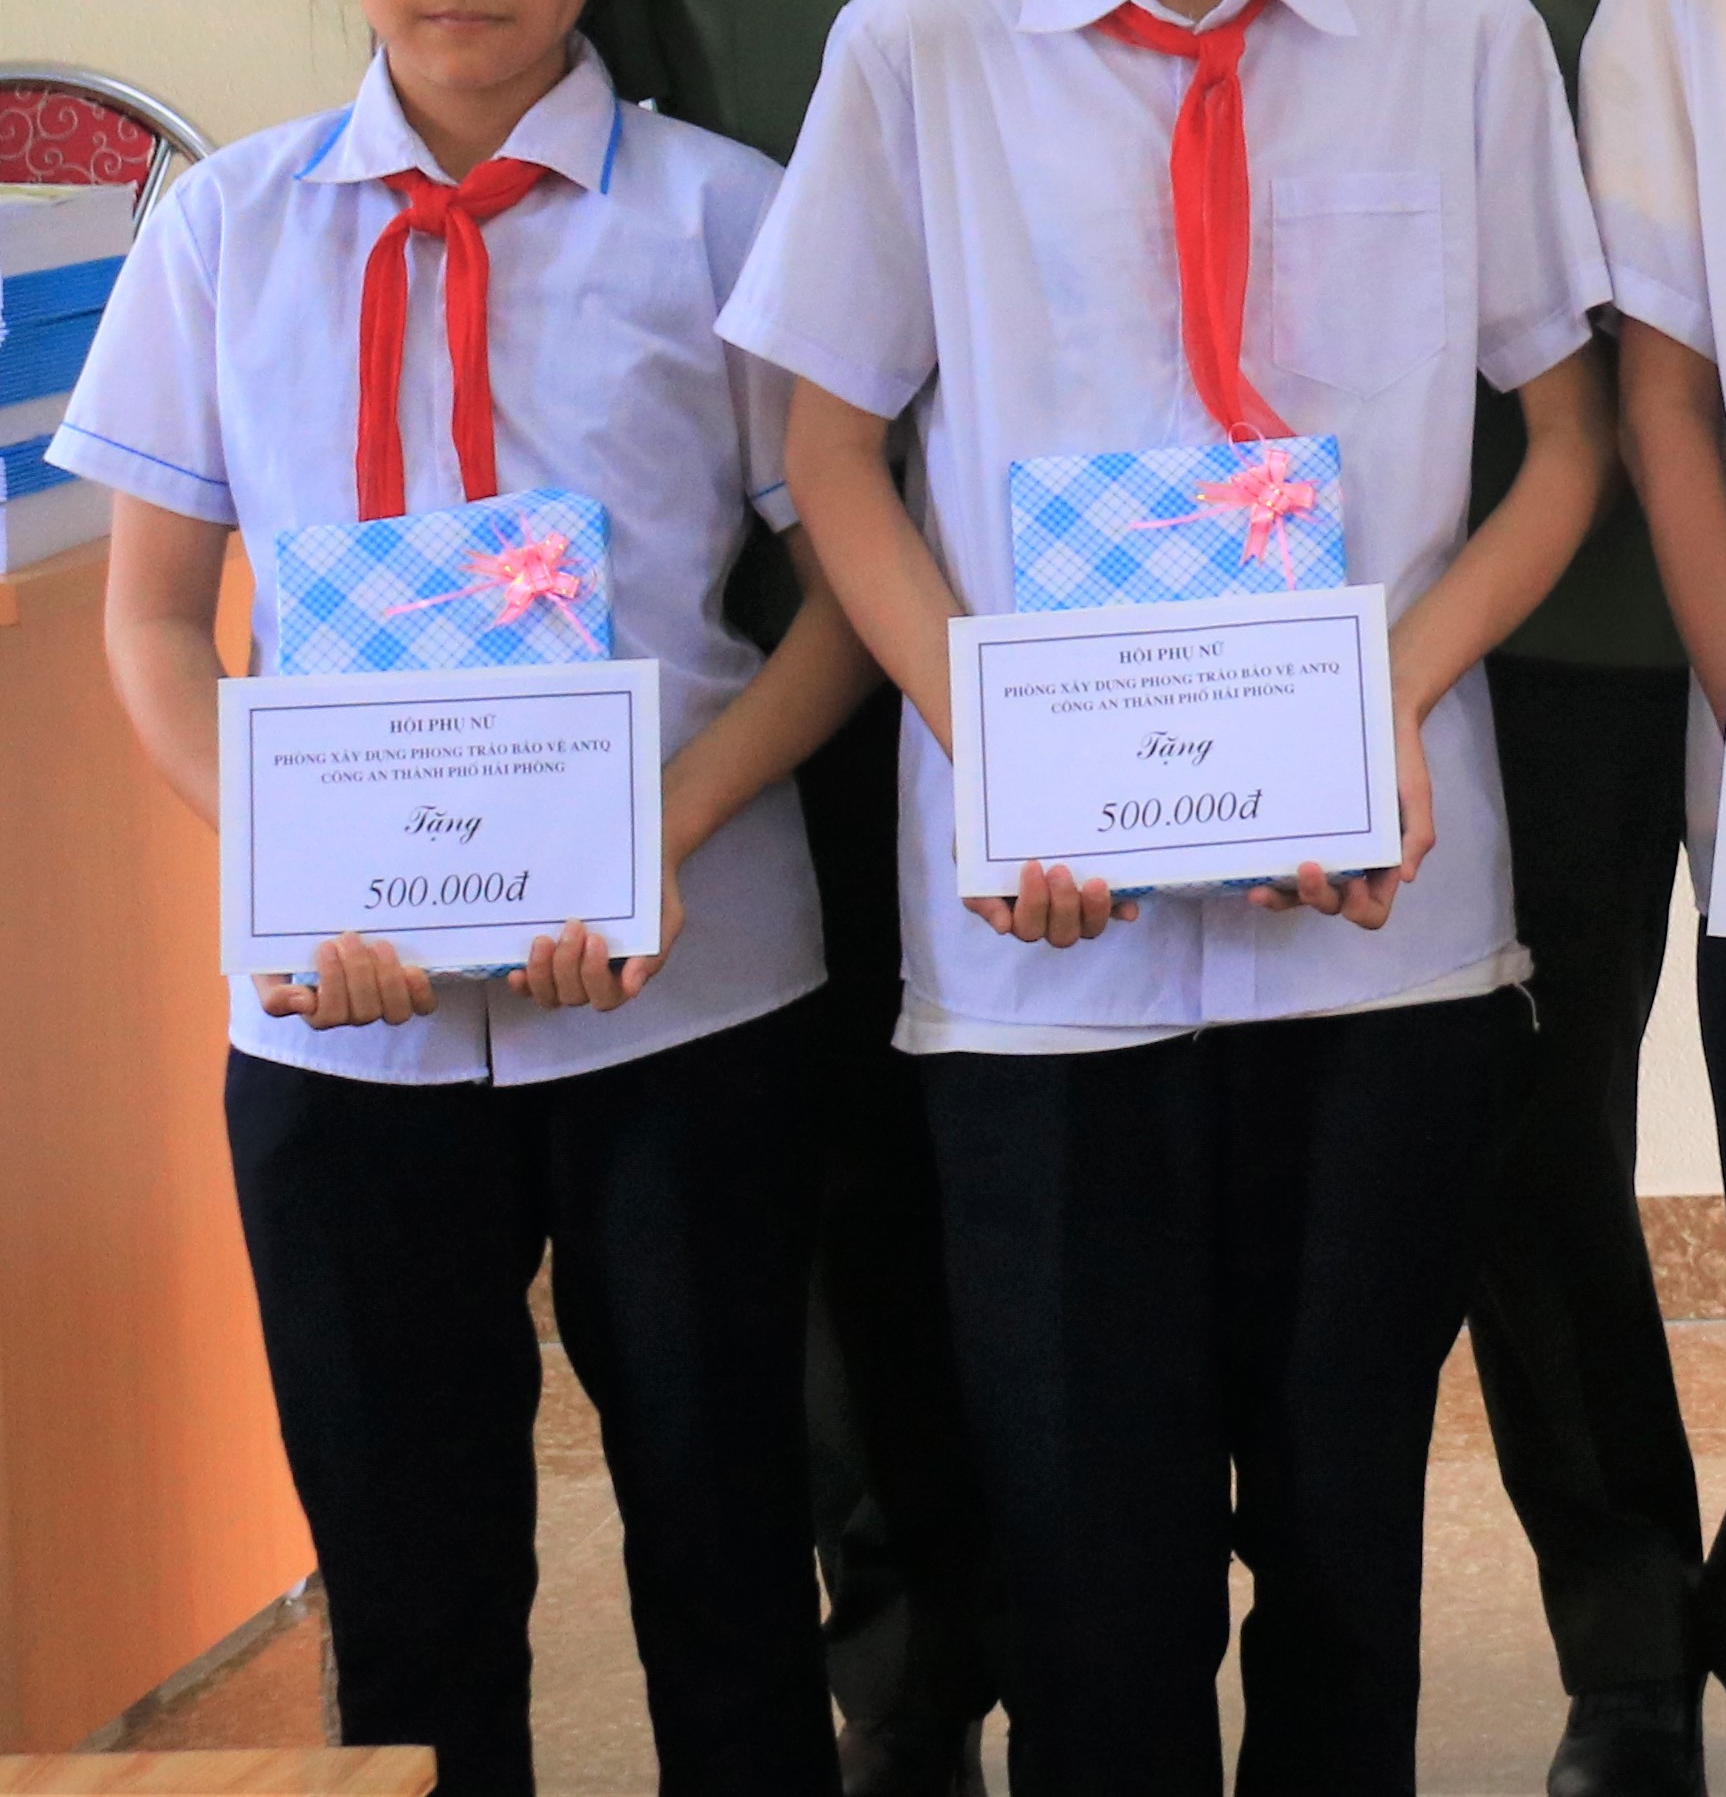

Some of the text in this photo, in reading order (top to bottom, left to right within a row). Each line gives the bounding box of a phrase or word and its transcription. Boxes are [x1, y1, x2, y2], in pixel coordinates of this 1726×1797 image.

[1119, 640, 1223, 664] HỘI PHỤ NỮ
[1004, 682, 1056, 698] PHÒNG
[1060, 680, 1090, 693] XÂY
[1140, 673, 1192, 688] PHONG
[1299, 661, 1340, 675] ANTQ
[1050, 699, 1093, 714] CÔNG
[1098, 698, 1118, 710] AN
[1178, 688, 1209, 704] PHỐ
[1242, 682, 1294, 698] PHÒNG
[390, 713, 496, 735] HỘI PHỤ NỮ
[273, 751, 326, 766] PHÒNG
[330, 749, 360, 763] XÂY
[410, 746, 463, 760] PHONG
[570, 739, 611, 753] ANTQ
[1136, 731, 1214, 765] Tặng
[320, 769, 363, 784] CÔNG
[367, 770, 387, 782] AN
[447, 763, 479, 778] PHỐ
[513, 759, 565, 774] PHÒNG
[404, 805, 482, 844] Tặng
[1097, 788, 1263, 832] 500.000đ
[364, 869, 529, 909] 500.000đ
